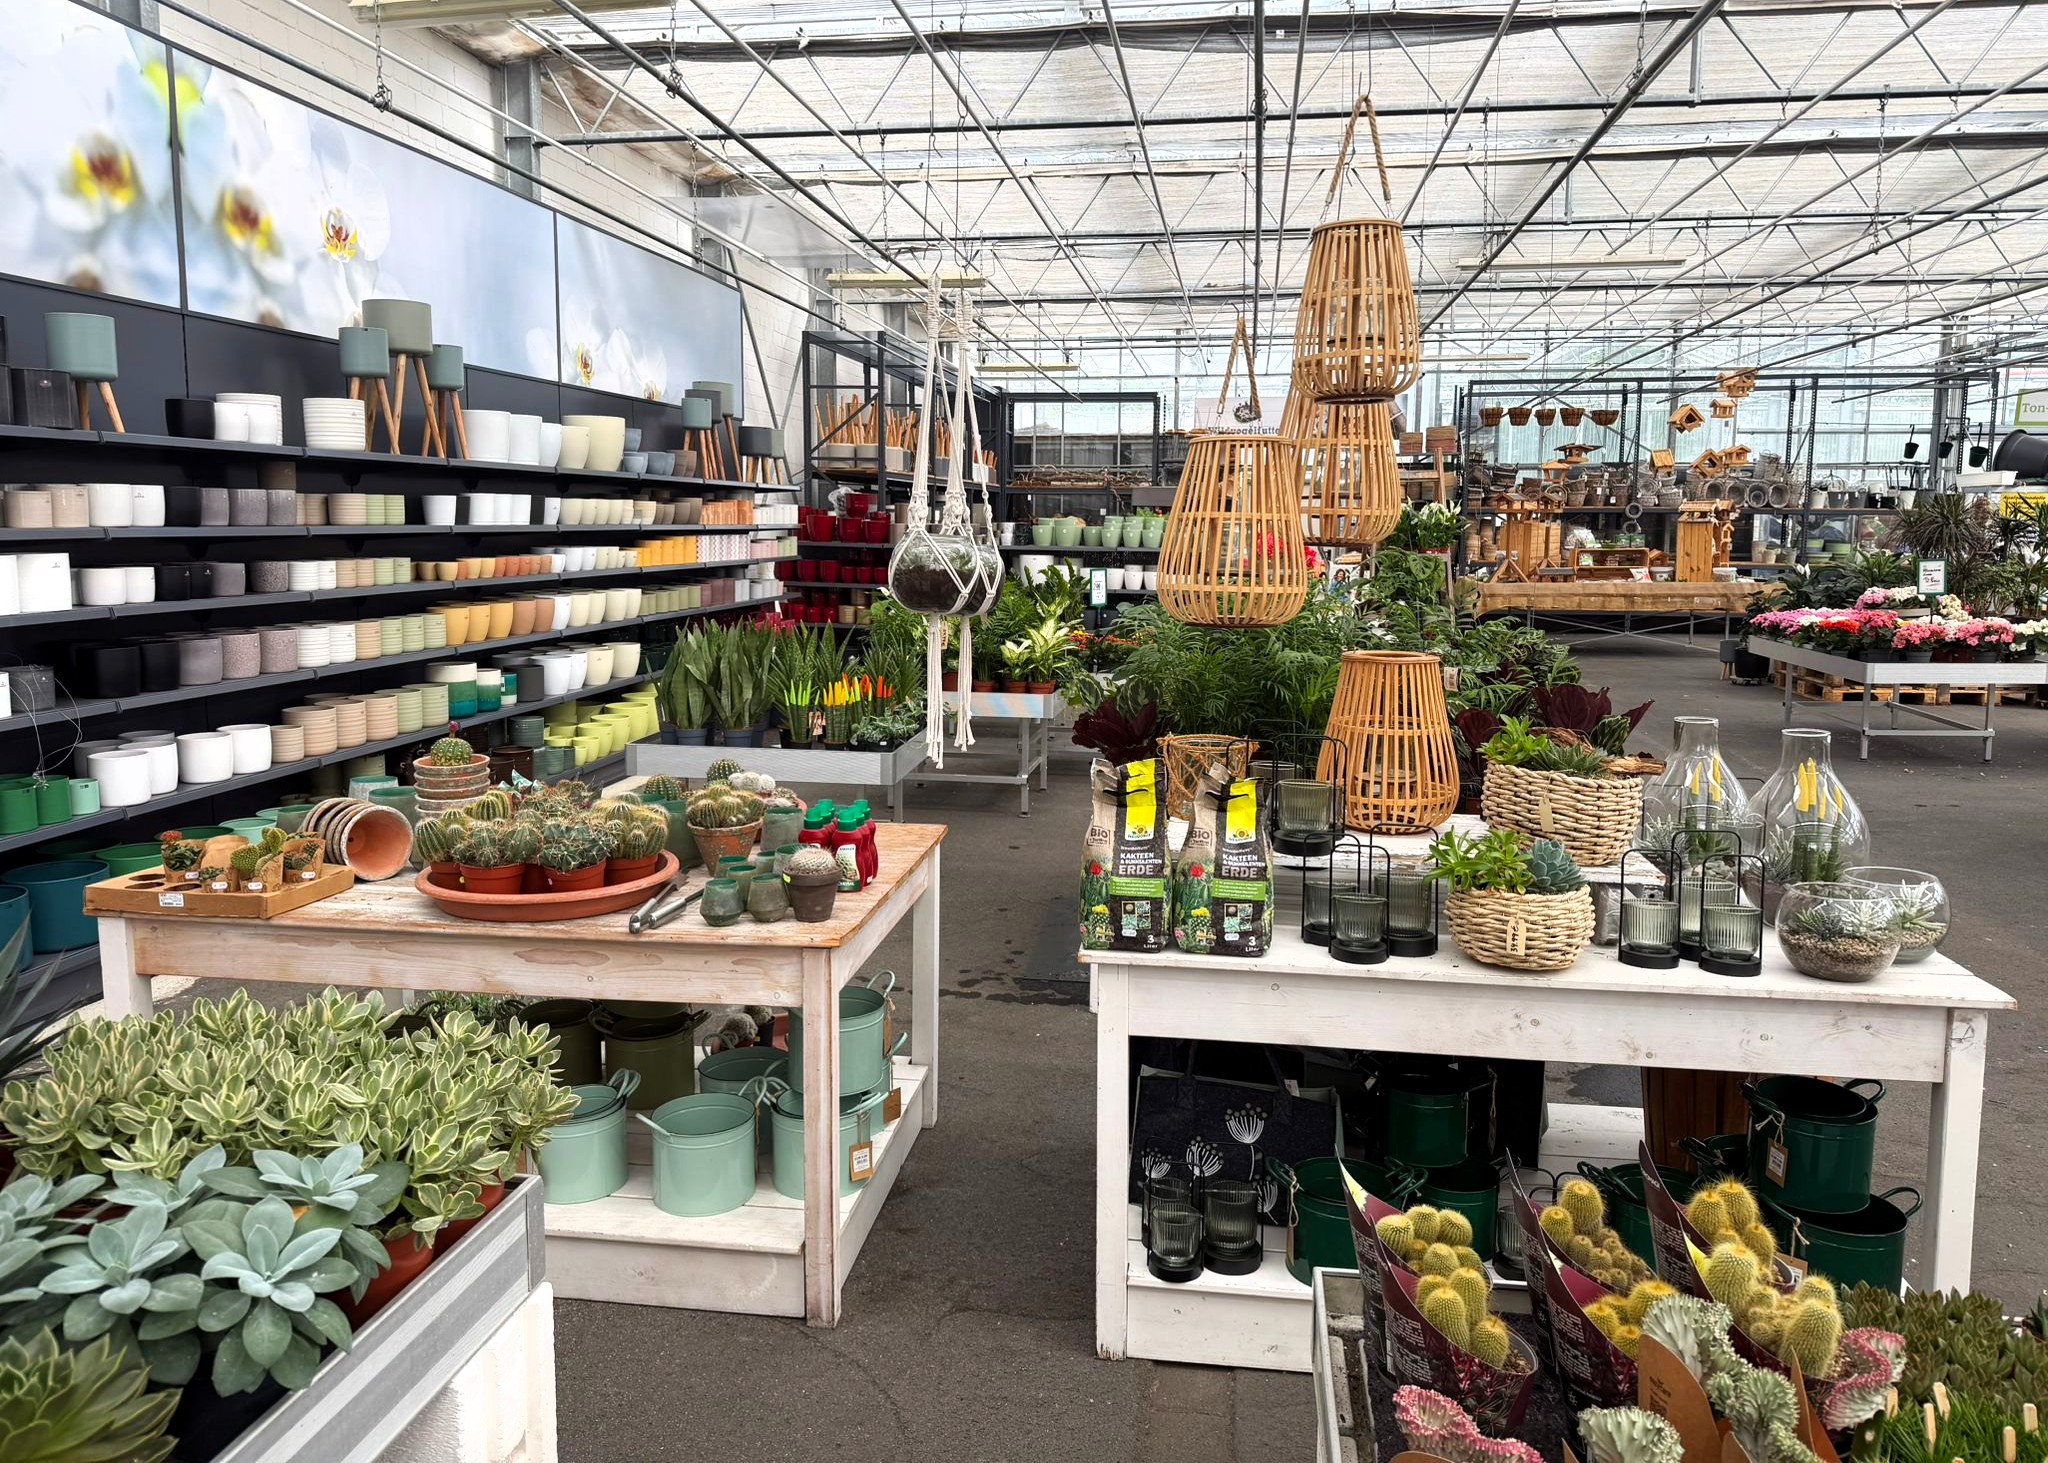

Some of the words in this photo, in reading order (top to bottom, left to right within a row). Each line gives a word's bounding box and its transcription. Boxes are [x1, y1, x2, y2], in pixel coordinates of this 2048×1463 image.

[1120, 852, 1154, 860] KAKTEEN
[1222, 853, 1258, 862] KAKTEEN
[1119, 865, 1154, 875] ERDE
[1222, 866, 1258, 878] ERDE
[1147, 934, 1155, 943] 3
[1248, 935, 1256, 946] 3
